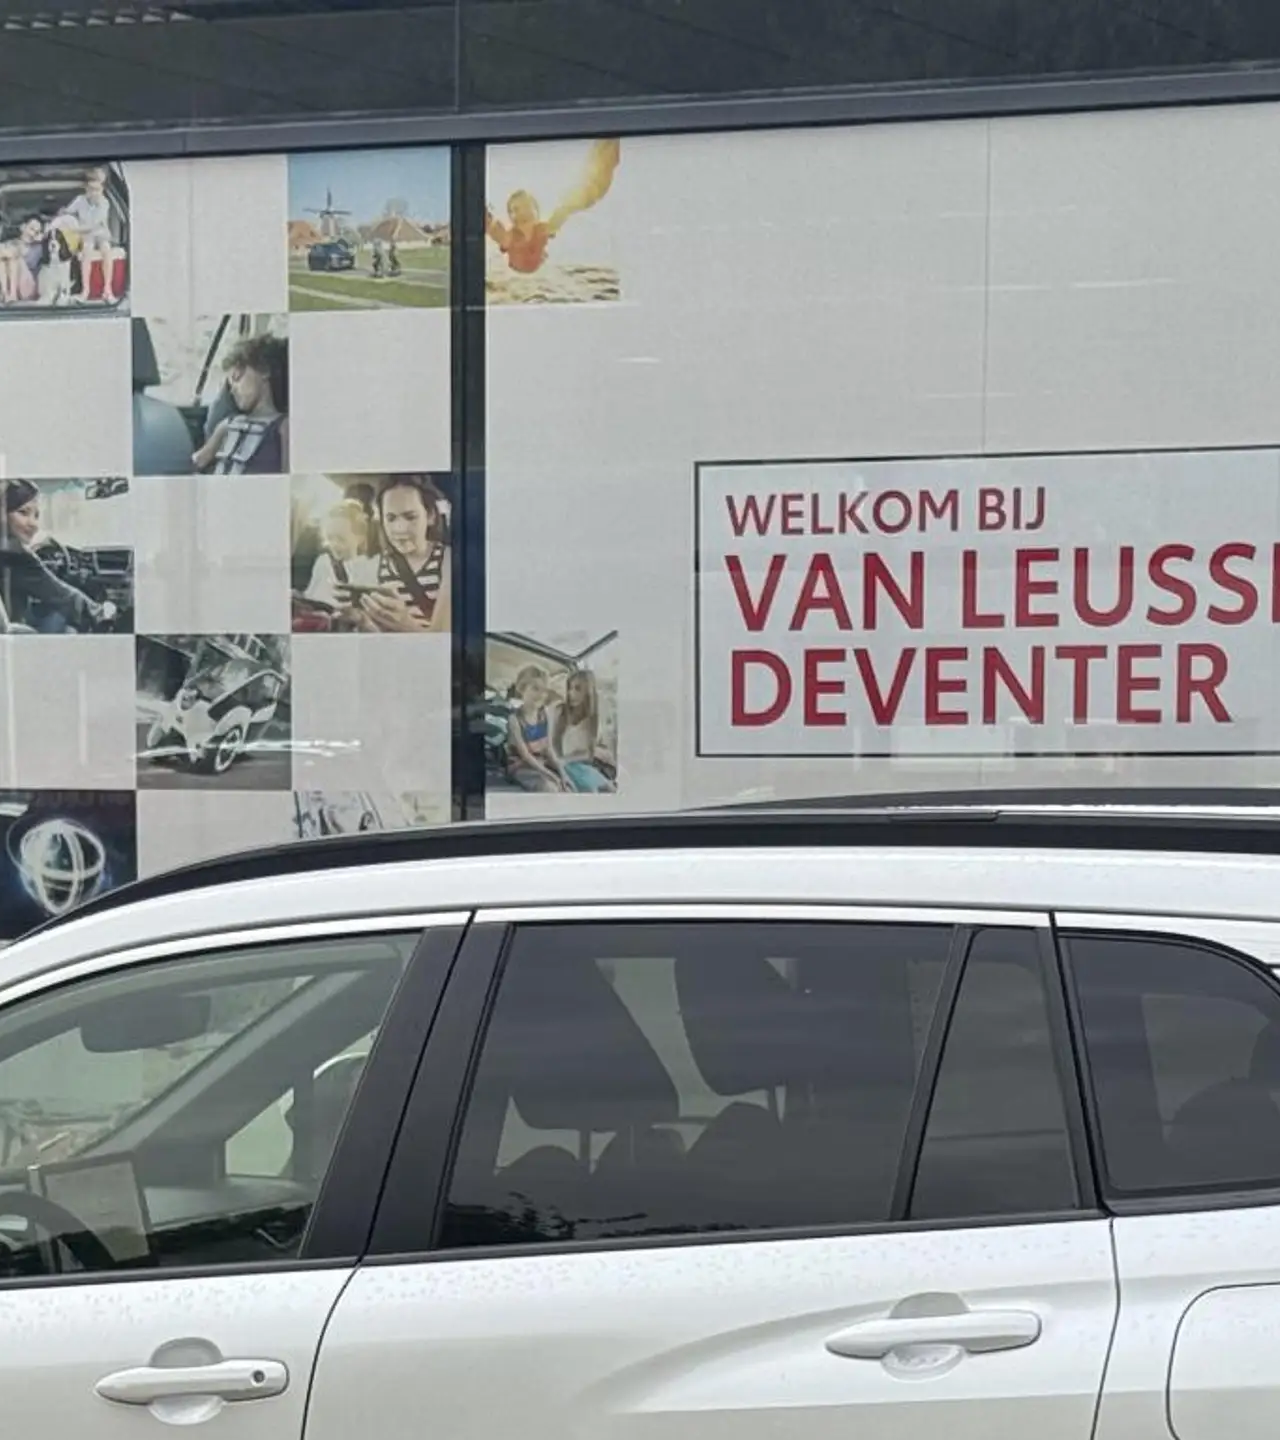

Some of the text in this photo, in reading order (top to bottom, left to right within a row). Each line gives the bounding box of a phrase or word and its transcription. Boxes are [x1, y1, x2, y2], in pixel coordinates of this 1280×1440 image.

[725, 486, 1046, 537] WELKOM BIJ
[723, 550, 925, 632] VAN
[730, 642, 1233, 728] DEVENTER
